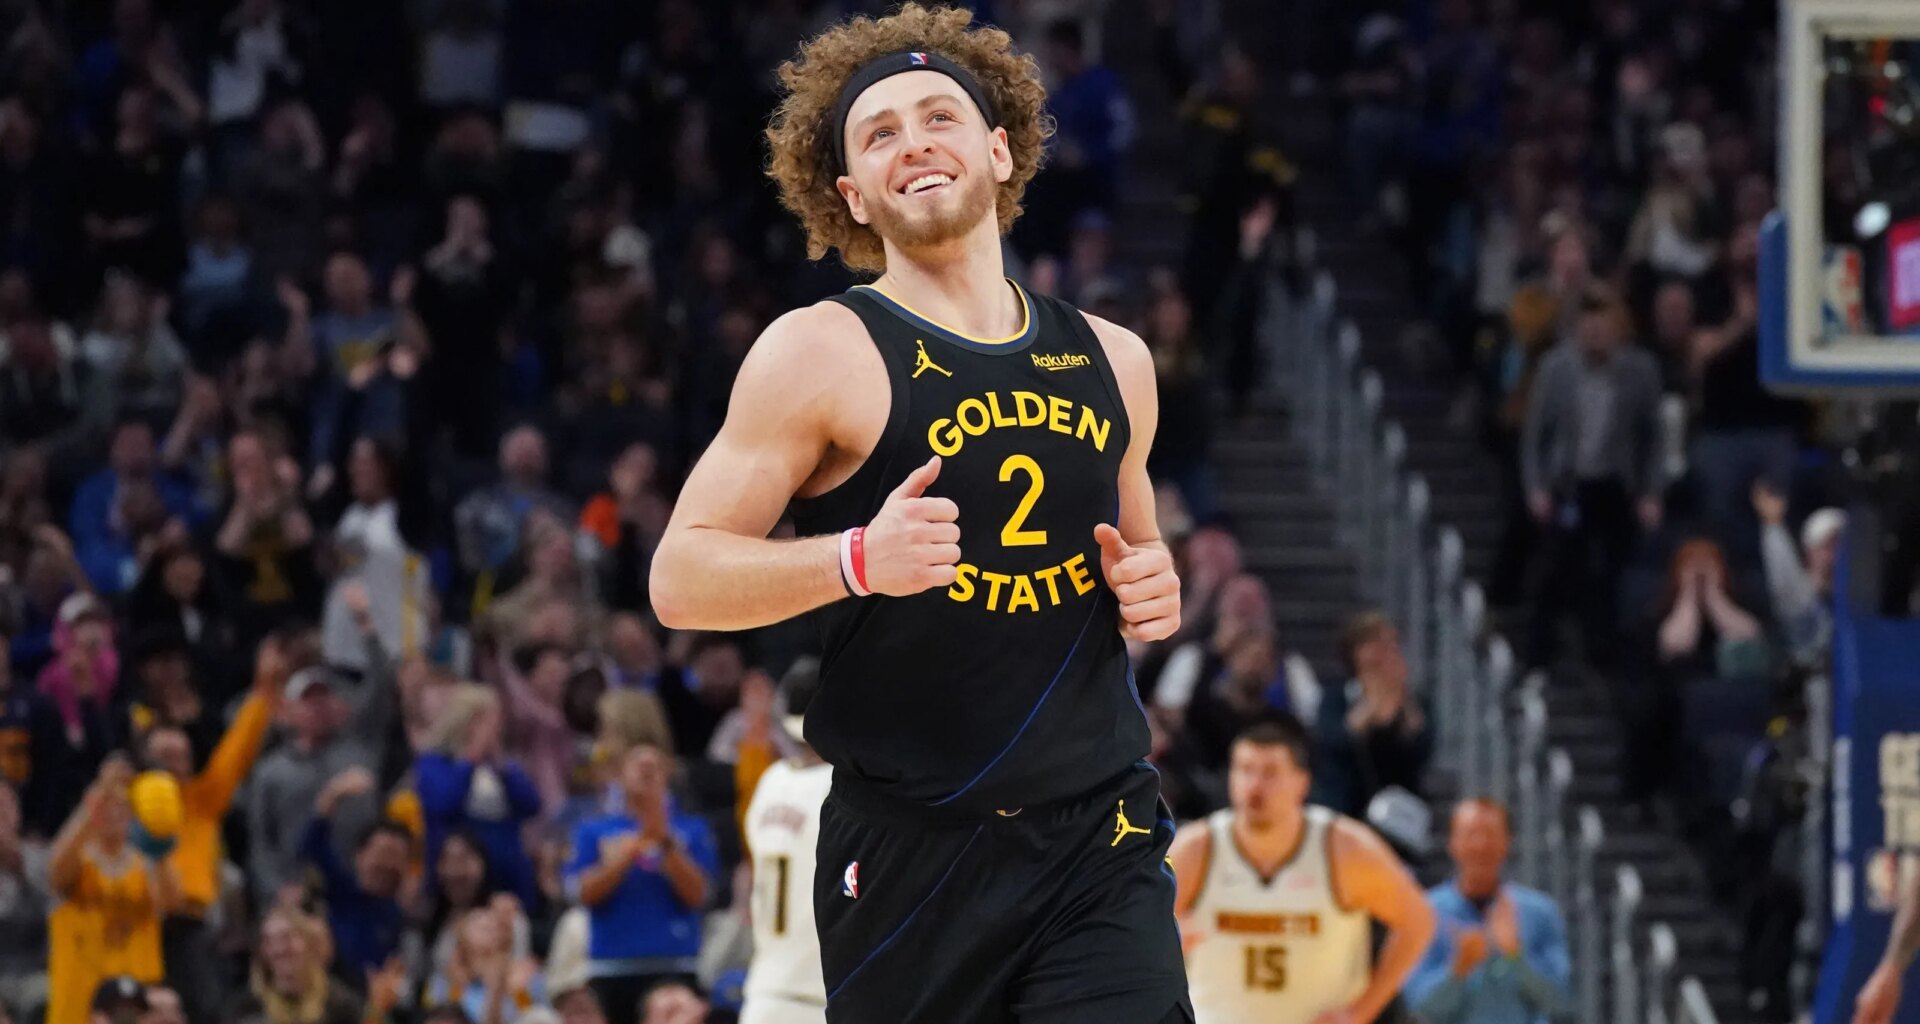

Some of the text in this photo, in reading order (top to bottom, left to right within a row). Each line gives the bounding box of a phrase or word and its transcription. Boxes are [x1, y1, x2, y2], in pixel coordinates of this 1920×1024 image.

[1030, 353, 1091, 368] Rakuten
[928, 391, 1111, 457] GOLDEN
[998, 454, 1047, 547] 2
[948, 553, 1096, 613] STATE
[1244, 946, 1286, 991] 15
